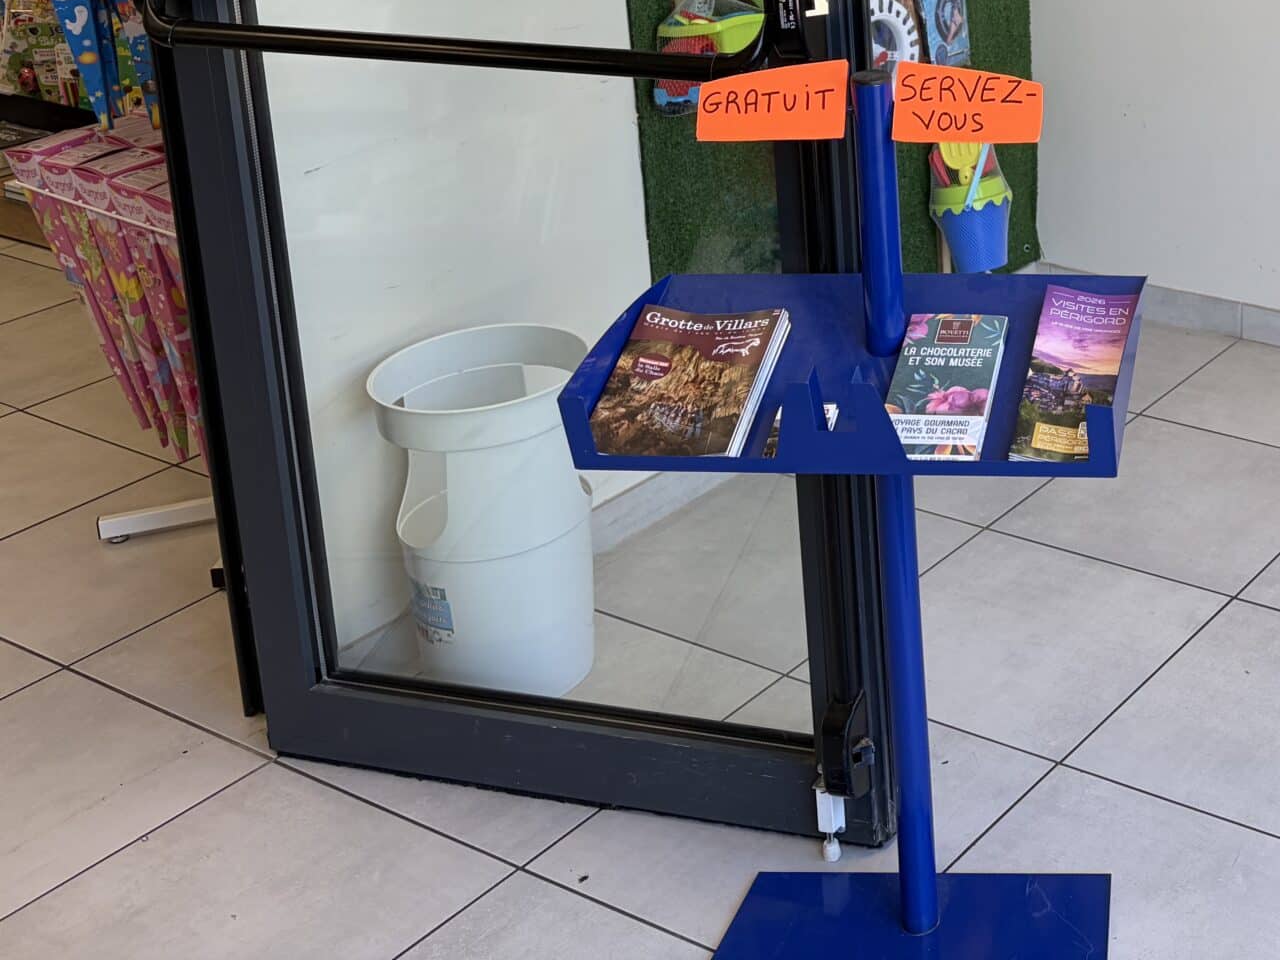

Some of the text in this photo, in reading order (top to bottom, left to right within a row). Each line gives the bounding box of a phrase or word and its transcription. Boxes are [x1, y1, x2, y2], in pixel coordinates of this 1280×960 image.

[900, 73, 1037, 105] SERVEZ-
[912, 110, 983, 133] VOUS
[1052, 298, 1129, 316] VISITES EN
[1077, 295, 1106, 305] 2026
[645, 311, 703, 331] Grotte
[715, 317, 770, 331] Villars
[1049, 307, 1127, 326] PÉRIGORD
[904, 347, 992, 358] LA CHOCOLATERIE
[908, 355, 984, 367] ET SON MUSÉE
[901, 427, 922, 435] PAYS
[941, 428, 968, 436] CACAO
[924, 420, 970, 428] GOURMAND
